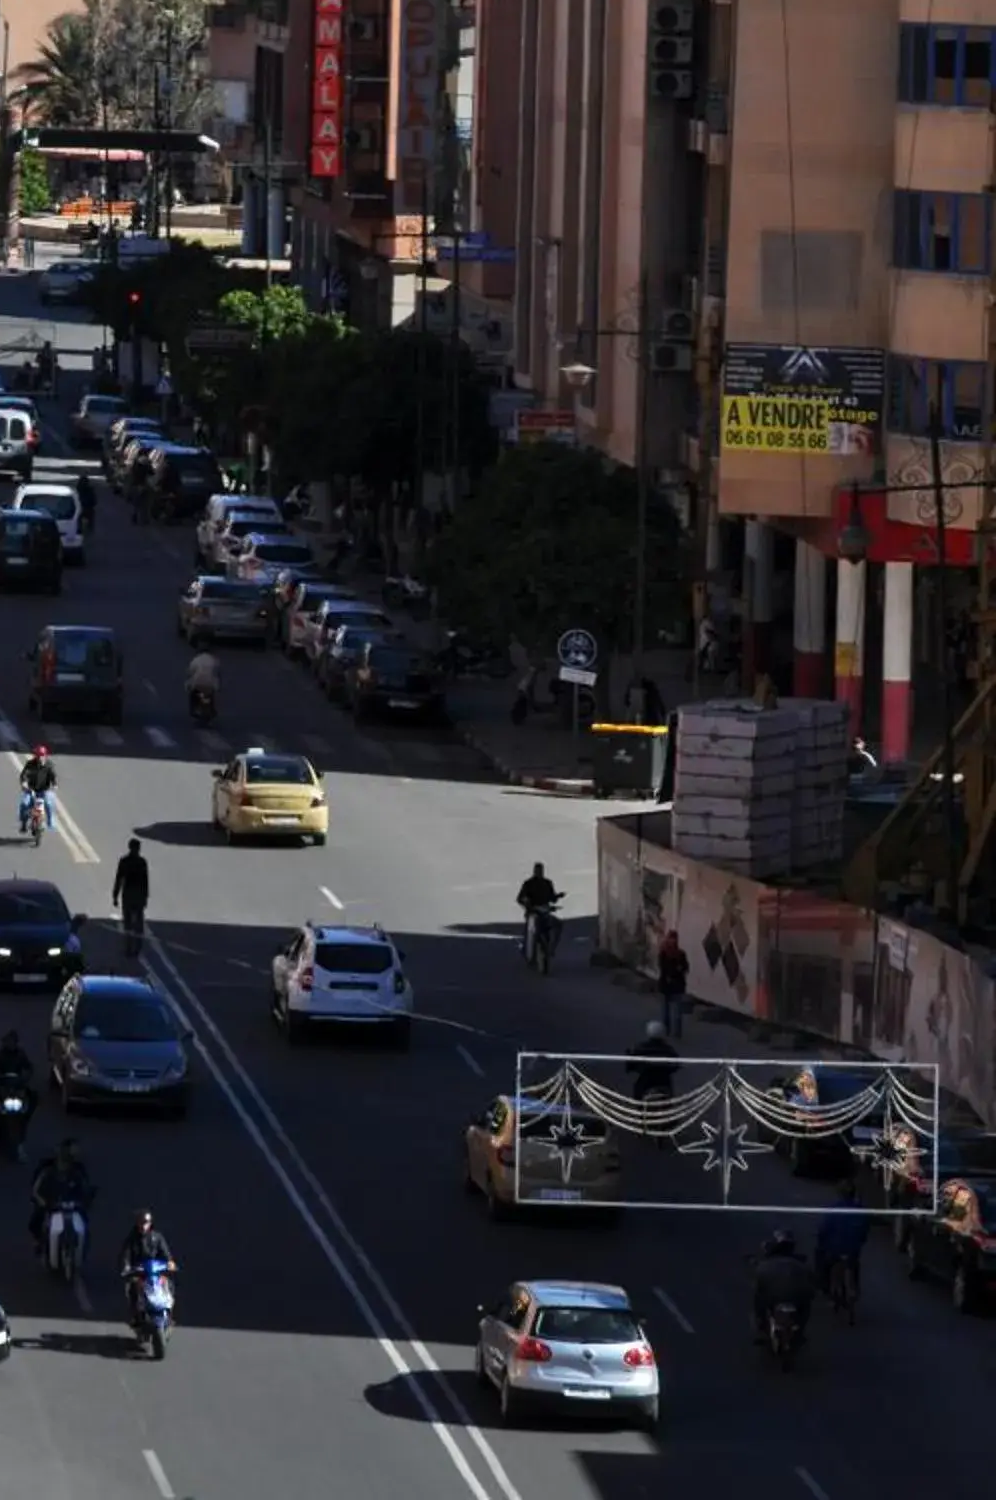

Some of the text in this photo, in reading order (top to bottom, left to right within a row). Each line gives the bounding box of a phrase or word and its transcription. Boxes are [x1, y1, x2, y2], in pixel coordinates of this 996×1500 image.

[727, 401, 826, 430] A VENDRE
[725, 429, 827, 449] 06 61 08 55 66
